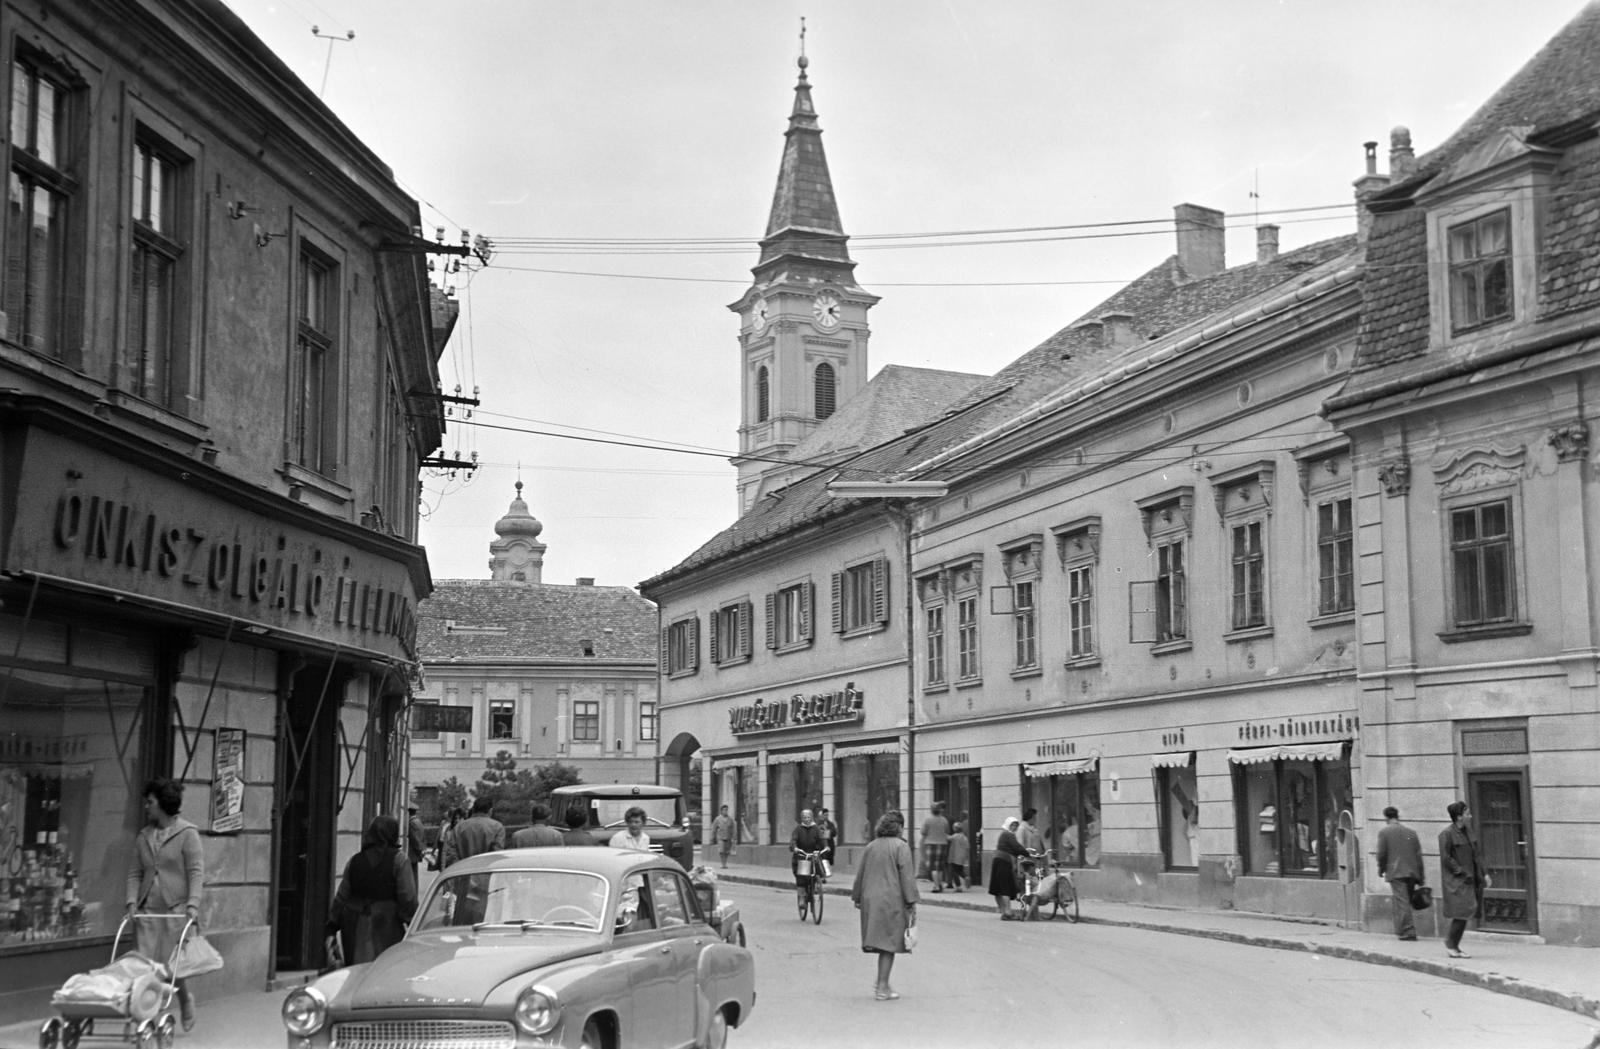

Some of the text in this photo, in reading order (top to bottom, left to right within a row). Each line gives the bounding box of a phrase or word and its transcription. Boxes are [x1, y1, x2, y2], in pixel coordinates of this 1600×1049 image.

[54, 469, 322, 616] ÖNKISZOLGÁLÓ
[1161, 728, 1185, 746] CIPŐ
[1036, 739, 1075, 758] MÉTERÁRU
